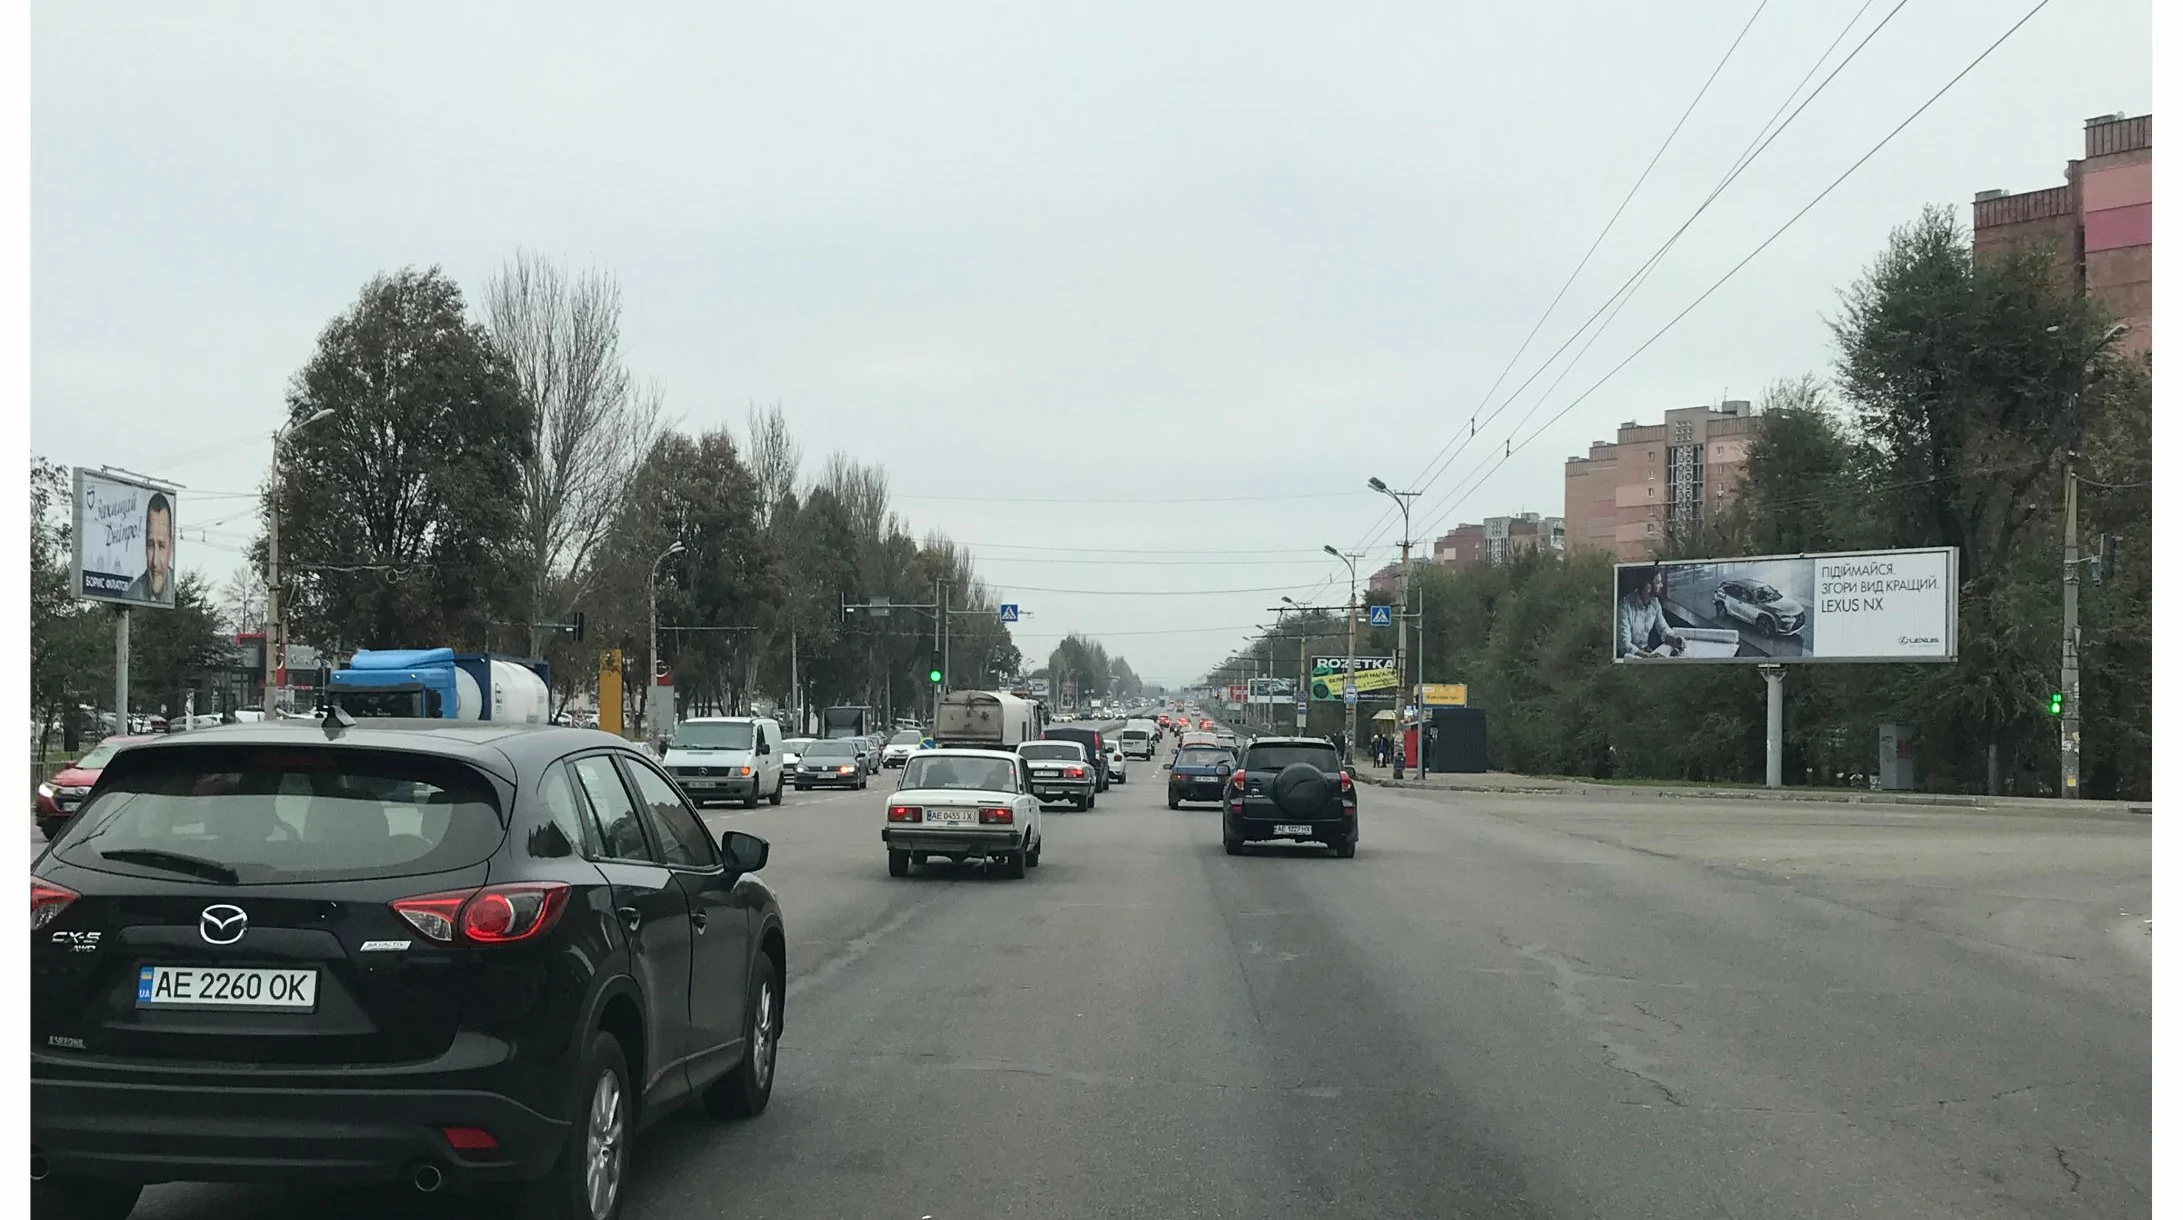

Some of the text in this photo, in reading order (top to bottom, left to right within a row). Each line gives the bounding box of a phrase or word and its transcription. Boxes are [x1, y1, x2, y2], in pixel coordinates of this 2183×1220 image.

[85, 576, 130, 592] БОРИС ФІЛАТОВ
[1821, 582, 1858, 594] ЗГОРИ
[1860, 580, 1884, 594] ВИД
[1821, 598, 1884, 613] LEXUS NX
[1316, 658, 1394, 669] ROZETKA
[931, 811, 942, 819] AE
[943, 811, 960, 820] 0455
[52, 931, 101, 944] CX-5
[155, 971, 308, 1001] AE 2260 OK
[139, 989, 150, 998] UA
